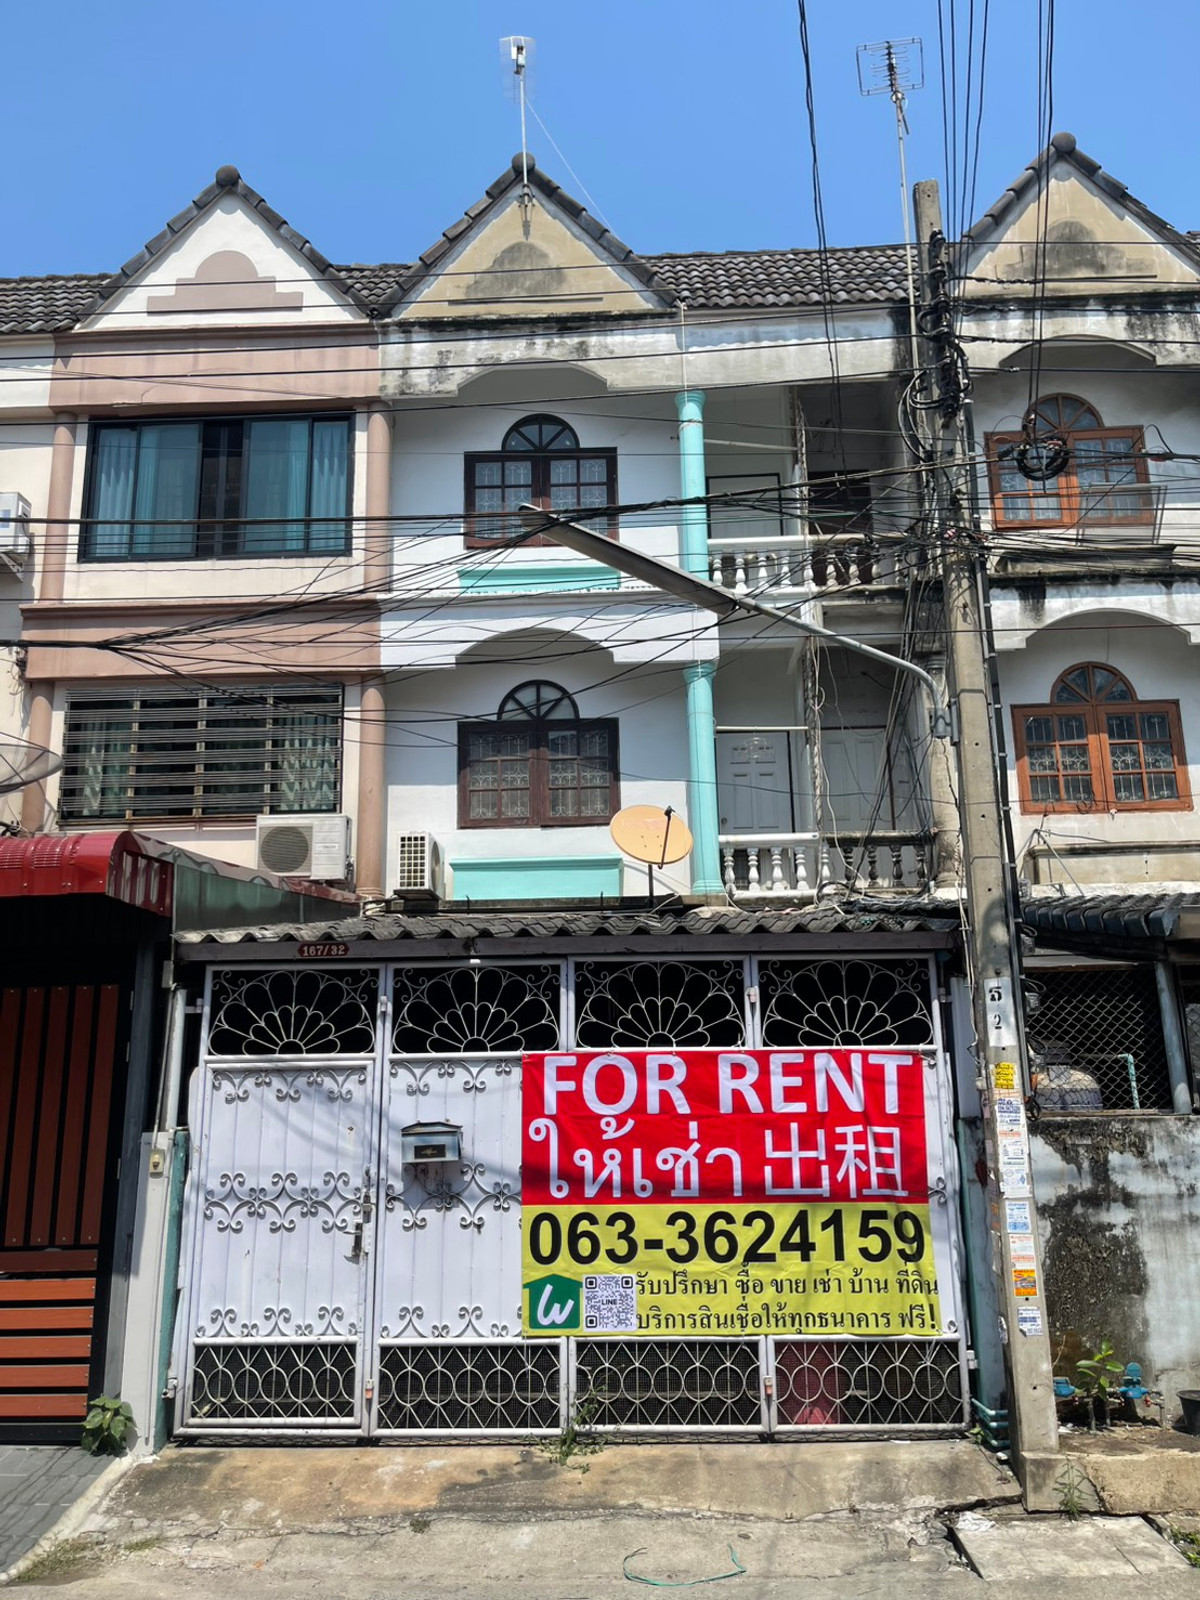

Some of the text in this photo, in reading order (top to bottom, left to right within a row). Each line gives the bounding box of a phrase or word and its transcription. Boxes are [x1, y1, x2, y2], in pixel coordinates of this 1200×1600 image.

[543, 1052, 913, 1116] FOR RENT
[528, 1117, 909, 1199] ให้เช่า 出租
[528, 1208, 926, 1265] 063-3624159
[635, 1260, 939, 1295] รับปรึกษา ซื้อ ขาย เช่า บ้าน ที่ดิน
[601, 1298, 618, 1306] LINE
[636, 1296, 936, 1334] บริการสินเชื่อให้ทุกธนาคาร ฟรี!
